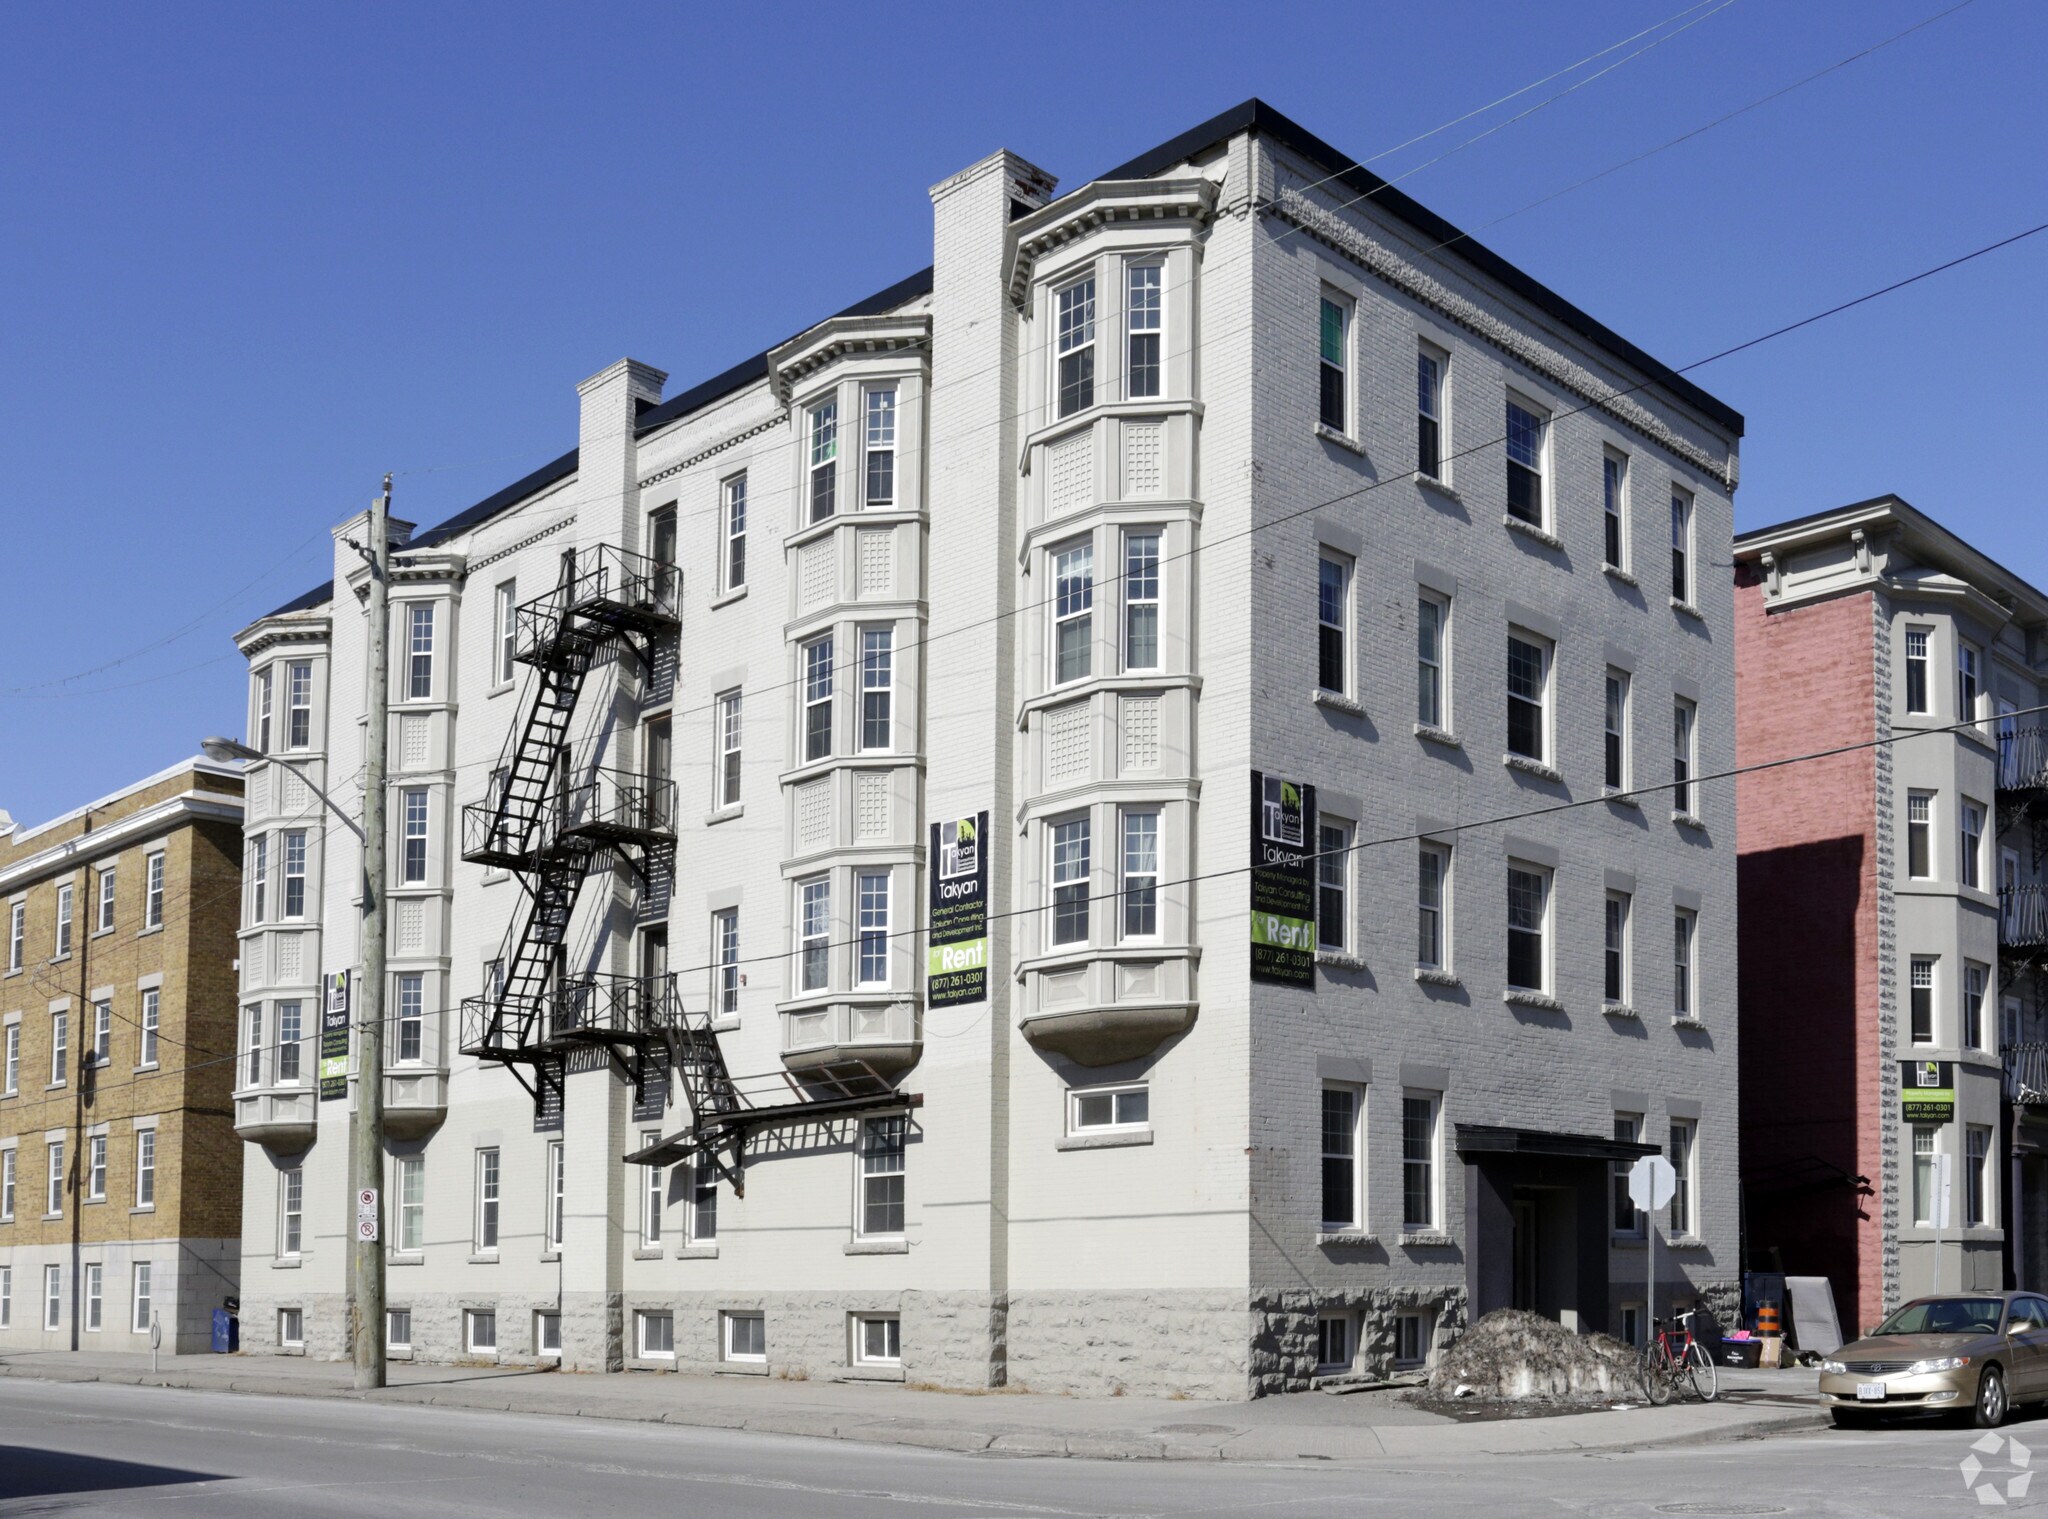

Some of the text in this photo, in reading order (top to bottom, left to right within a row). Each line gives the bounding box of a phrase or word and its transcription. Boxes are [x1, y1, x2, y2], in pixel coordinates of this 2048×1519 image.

[1262, 843, 1304, 868] Takyan
[939, 879, 978, 899] Takyan
[1255, 881, 1310, 904] Takyan Consulting
[932, 900, 983, 917] General Contractor
[931, 929, 942, 939] and
[942, 924, 974, 938] Development
[1267, 916, 1310, 948] Rent
[942, 940, 983, 971] Rent
[1255, 947, 1310, 968] (877) 261-0301
[931, 972, 983, 992] (877) 261-0301
[931, 986, 982, 1001] www.takyan.com
[327, 1015, 346, 1028] Takyan
[327, 1057, 347, 1076] Rent
[1905, 1103, 1951, 1111] (877) 261-0301
